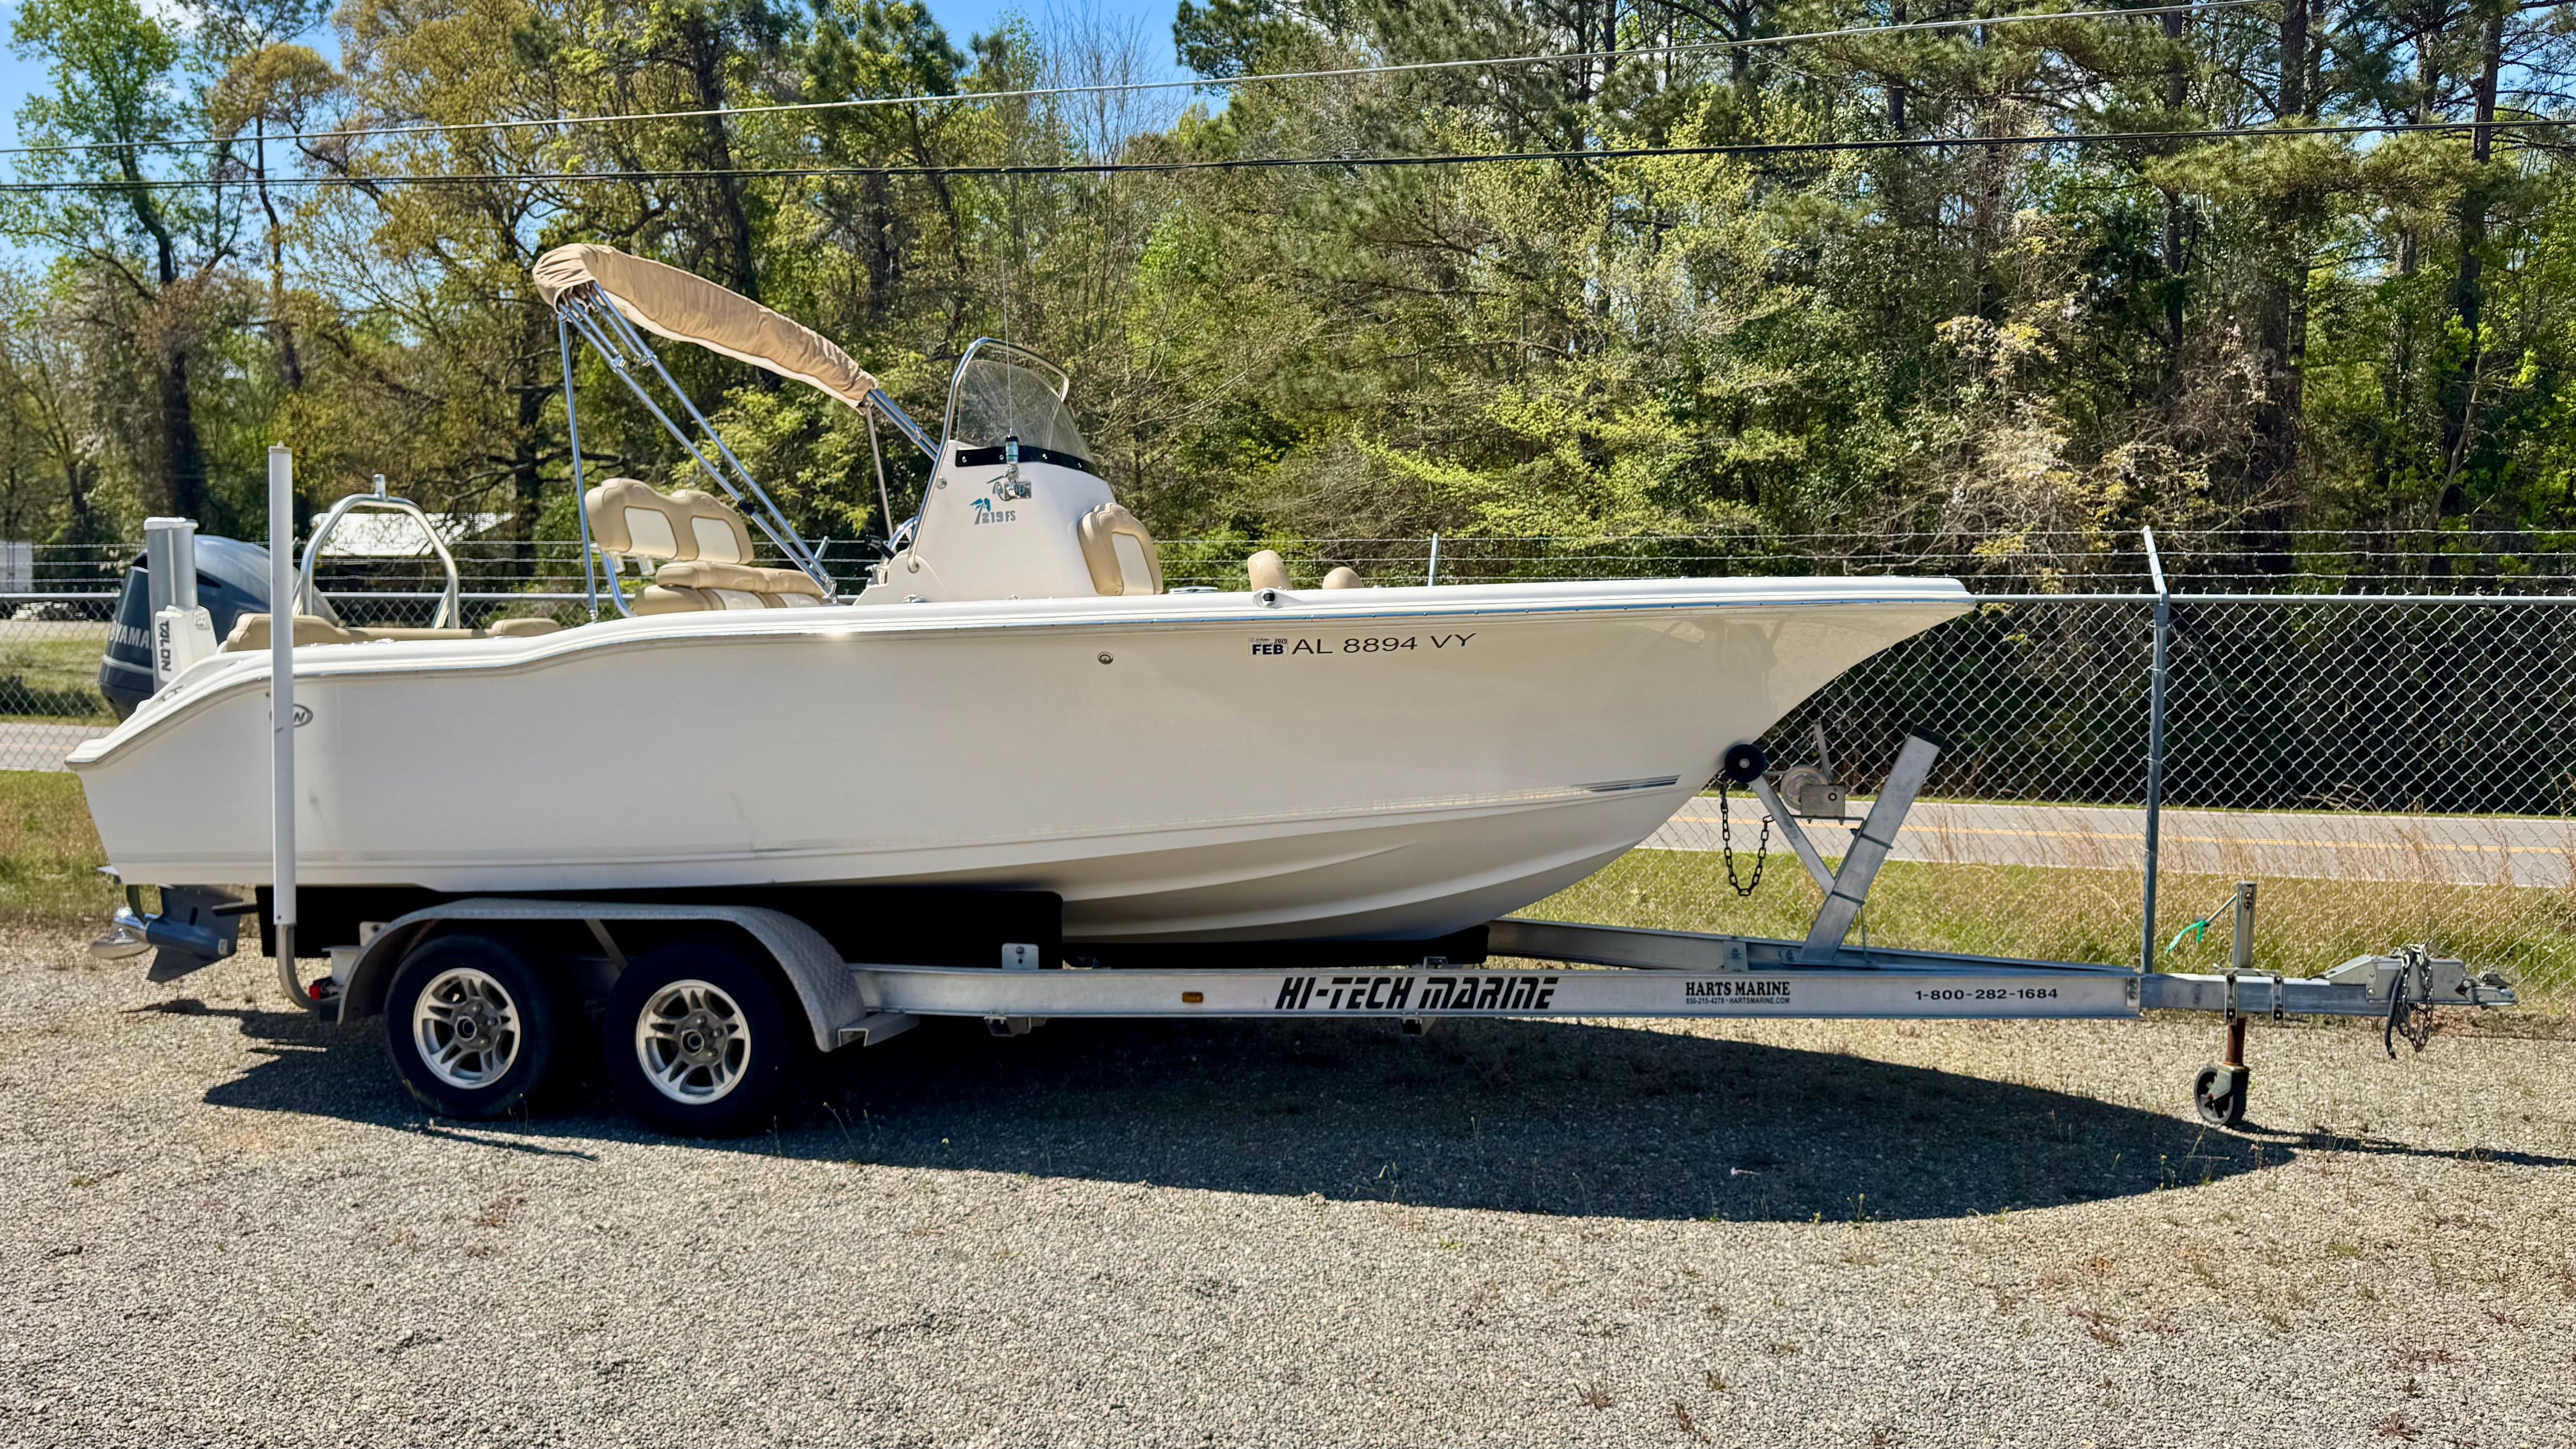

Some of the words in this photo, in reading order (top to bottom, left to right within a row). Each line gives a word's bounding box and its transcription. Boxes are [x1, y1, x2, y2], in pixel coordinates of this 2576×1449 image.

[982, 511, 1003, 524] 219
[1006, 510, 1016, 522] FS
[115, 622, 152, 650] YAMA
[1292, 639, 1333, 654] AL
[1343, 637, 1418, 653] 8894
[1430, 633, 1477, 649] VY
[159, 619, 171, 672] TALON
[1252, 644, 1283, 655] FEB
[1274, 977, 1415, 1009] HI-TECH
[1418, 977, 1559, 1009] MARINE
[1685, 982, 1732, 996] HARTS
[1734, 981, 1790, 996] MARINE
[1915, 988, 2058, 1000] 1-800-282-1684
